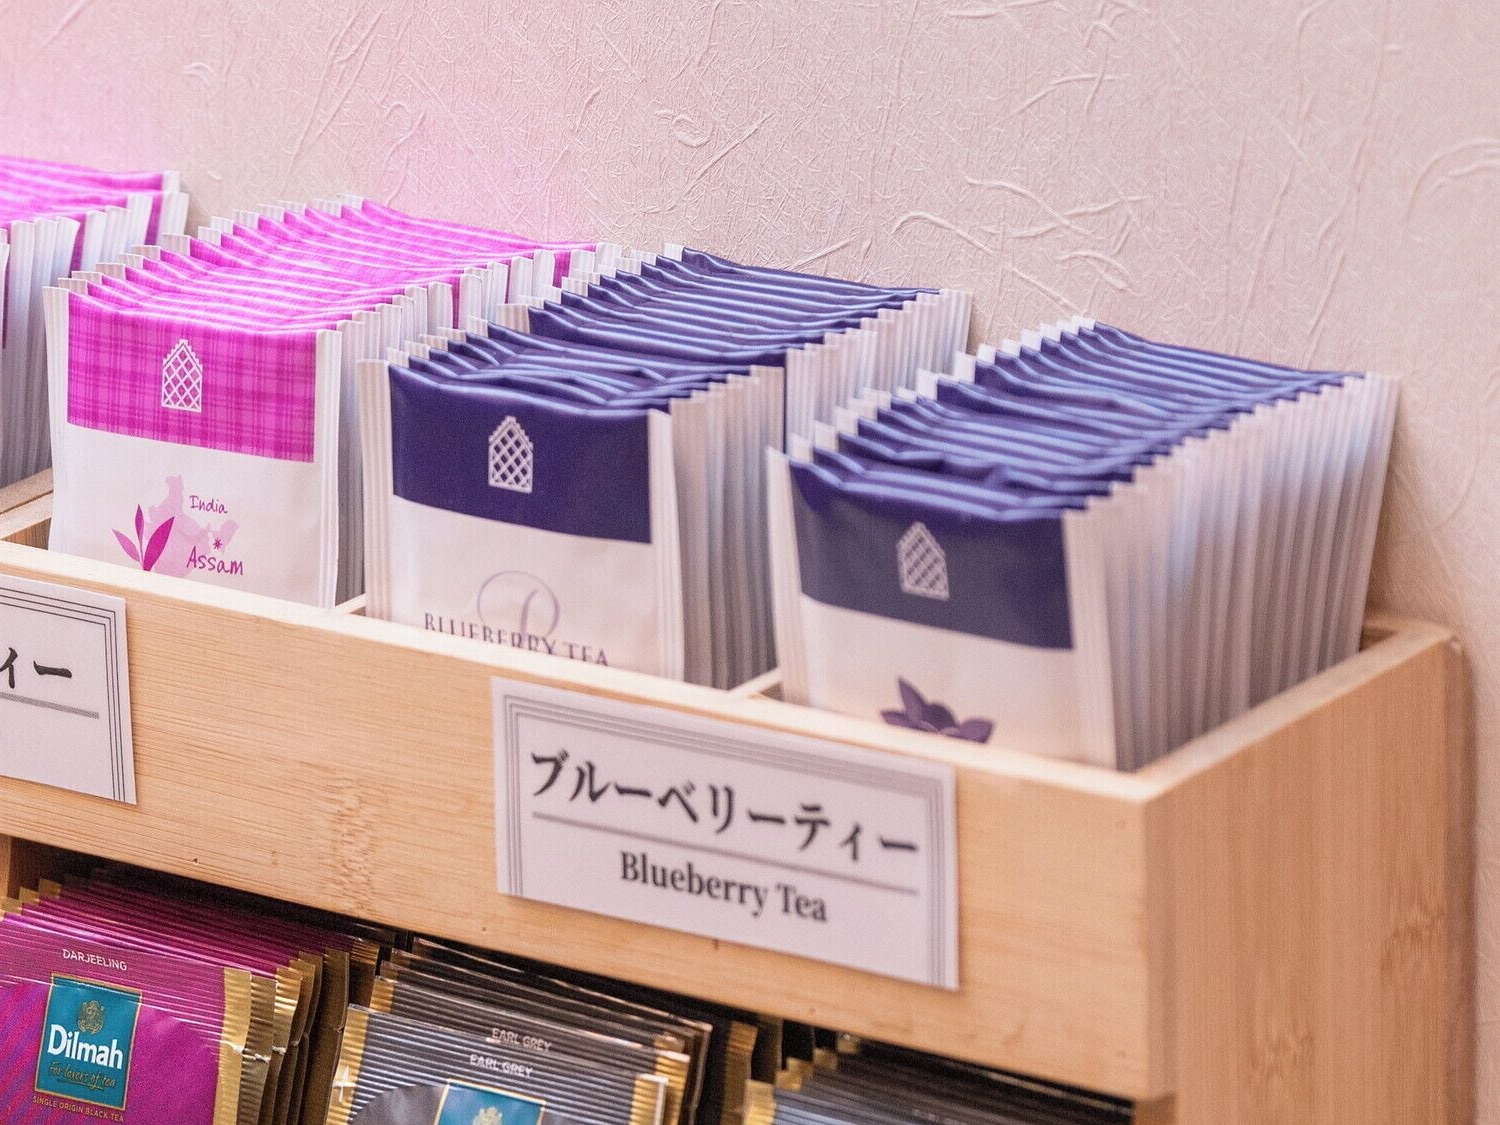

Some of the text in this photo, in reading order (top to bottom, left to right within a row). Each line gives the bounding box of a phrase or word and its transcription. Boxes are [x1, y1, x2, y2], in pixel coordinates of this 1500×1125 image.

[189, 494, 228, 514] India
[186, 545, 244, 576] Assam
[531, 748, 920, 863] ブルーベリーティー
[620, 850, 829, 923] Blueberry Tea
[62, 948, 127, 971] DARJEELING
[47, 1024, 124, 1070] Dilmah
[491, 1027, 553, 1052] EARL GREY
[469, 1053, 534, 1077] EARL GREY
[32, 1095, 124, 1122] SINGLE ORIGIN BLACK TEA
